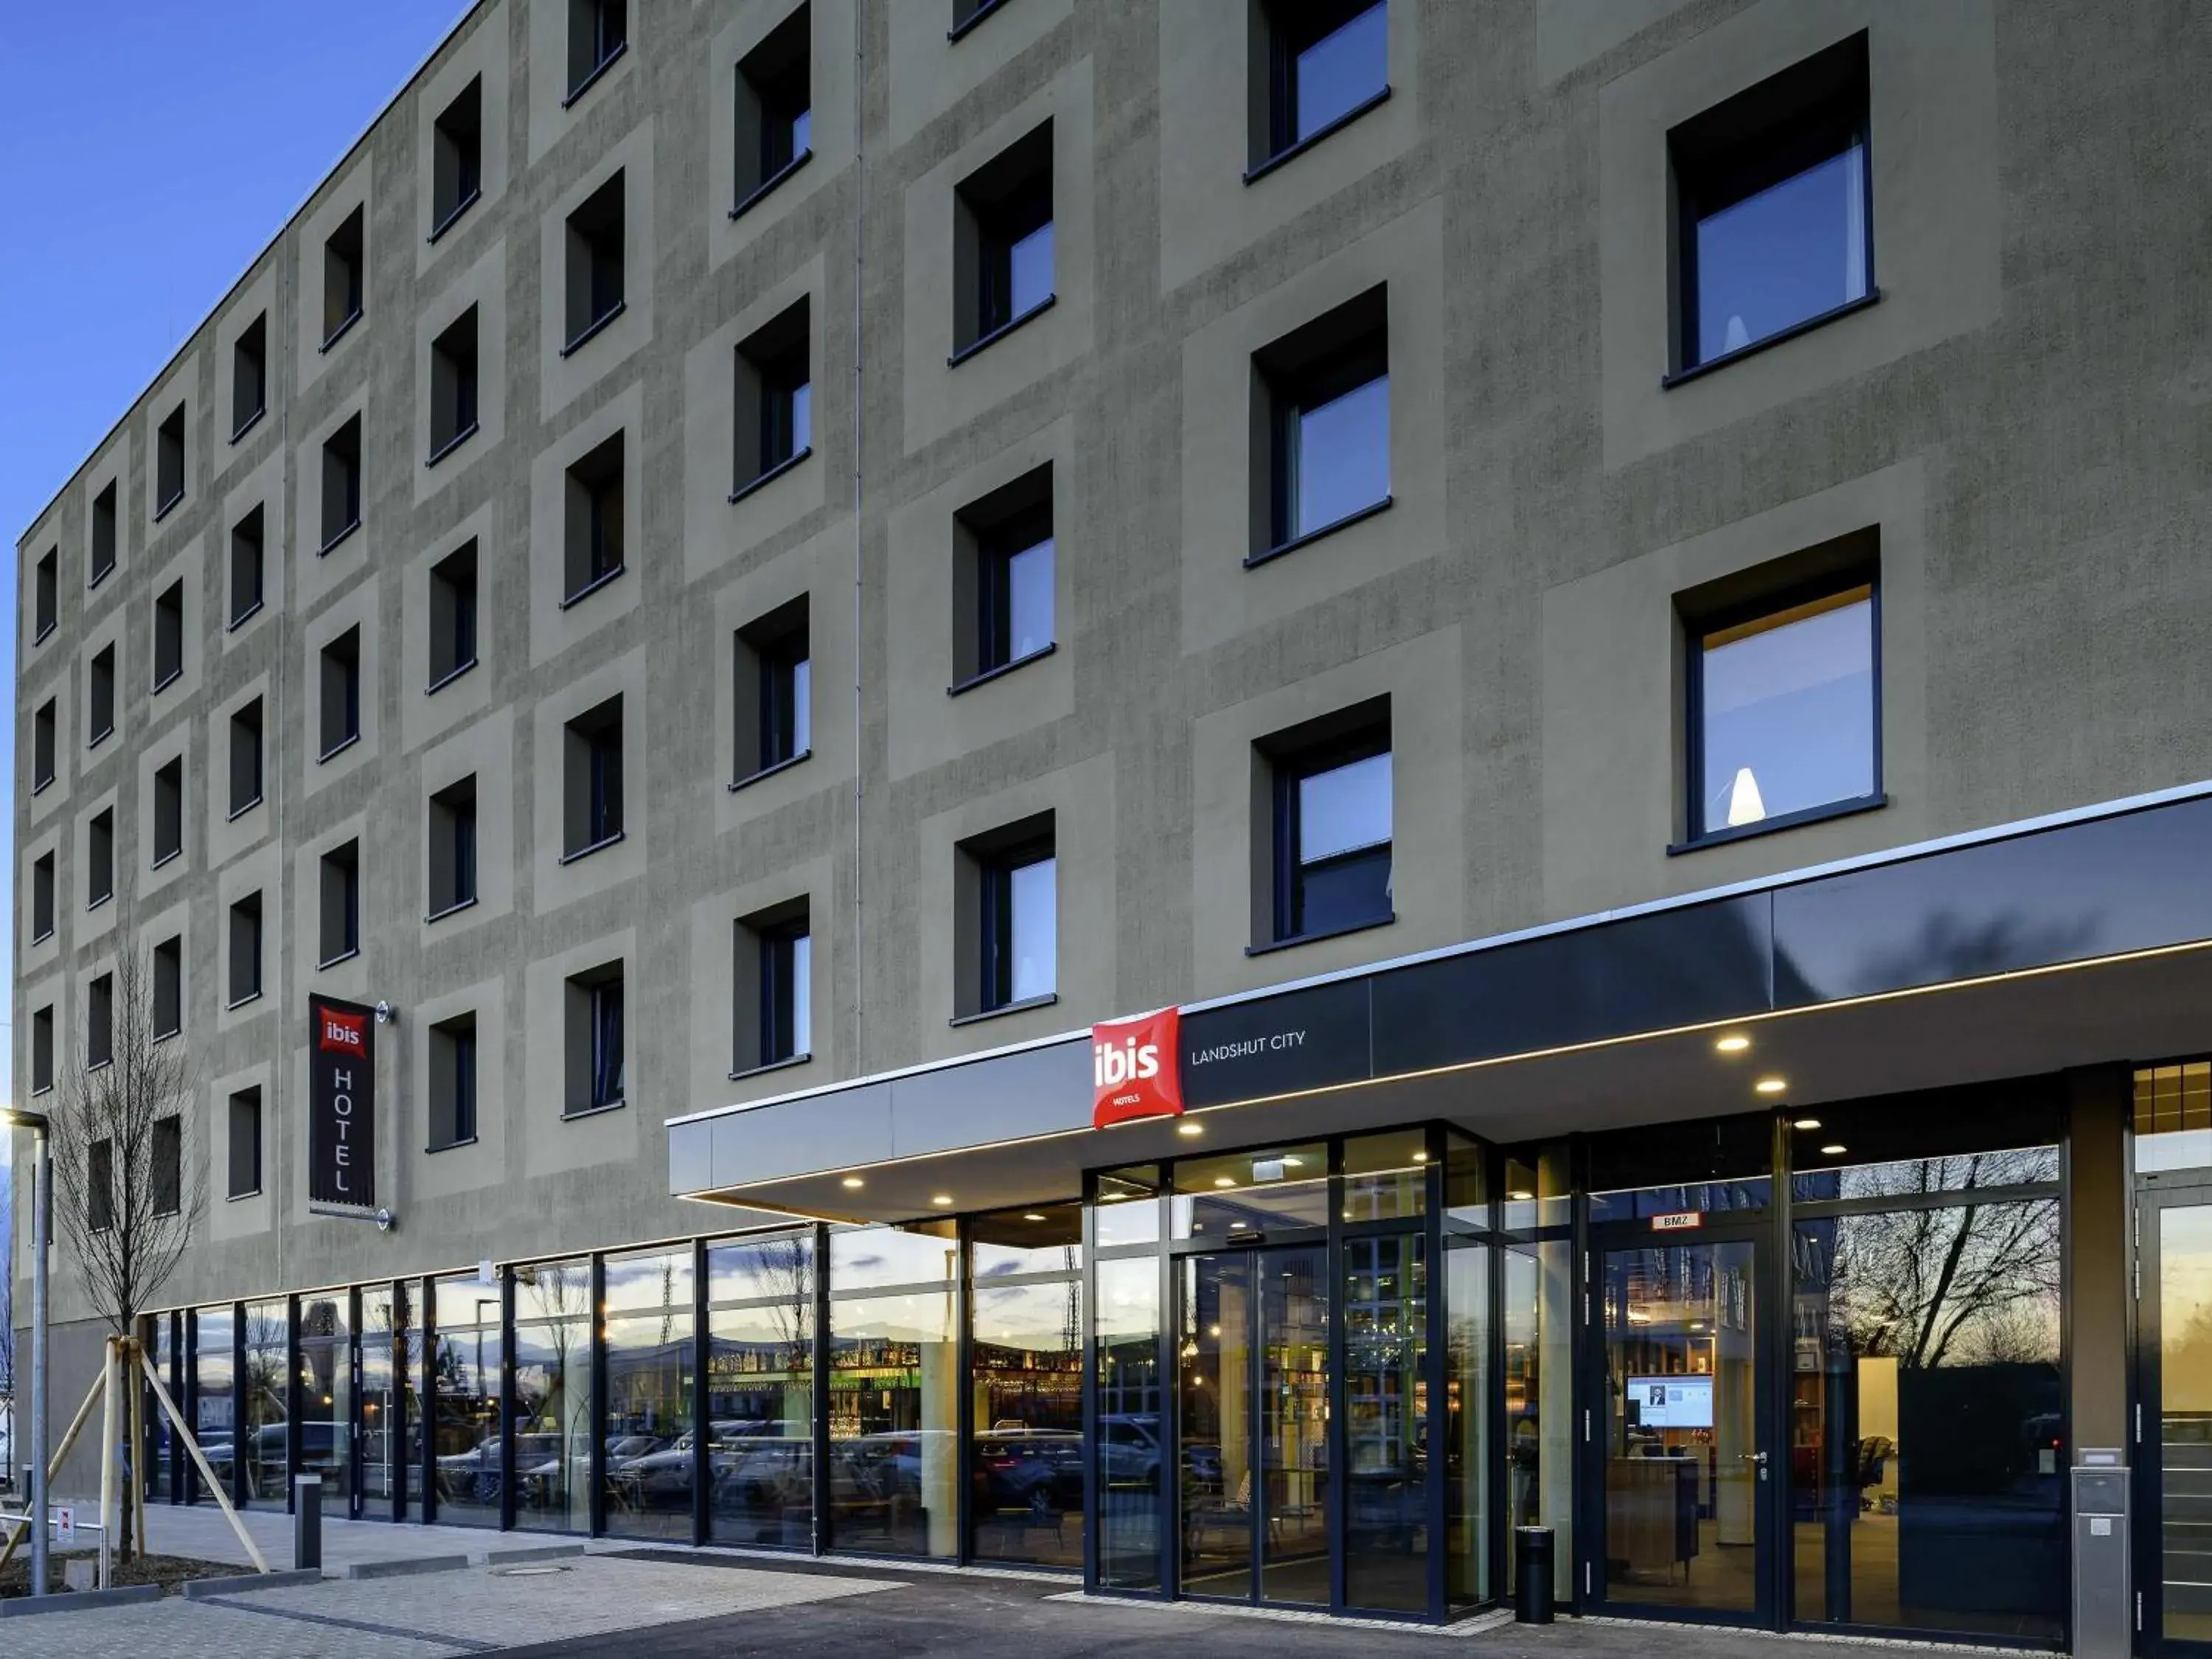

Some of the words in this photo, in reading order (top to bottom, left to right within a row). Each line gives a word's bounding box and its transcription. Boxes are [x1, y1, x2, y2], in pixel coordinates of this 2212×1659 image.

[327, 1021, 360, 1046] ibis
[1192, 1037, 1267, 1066] LANDSHUT
[1270, 1030, 1306, 1050] CITY
[1095, 1037, 1158, 1087] ibis
[1113, 1093, 1141, 1107] HOTELS
[334, 1068, 352, 1192] HOTEL
